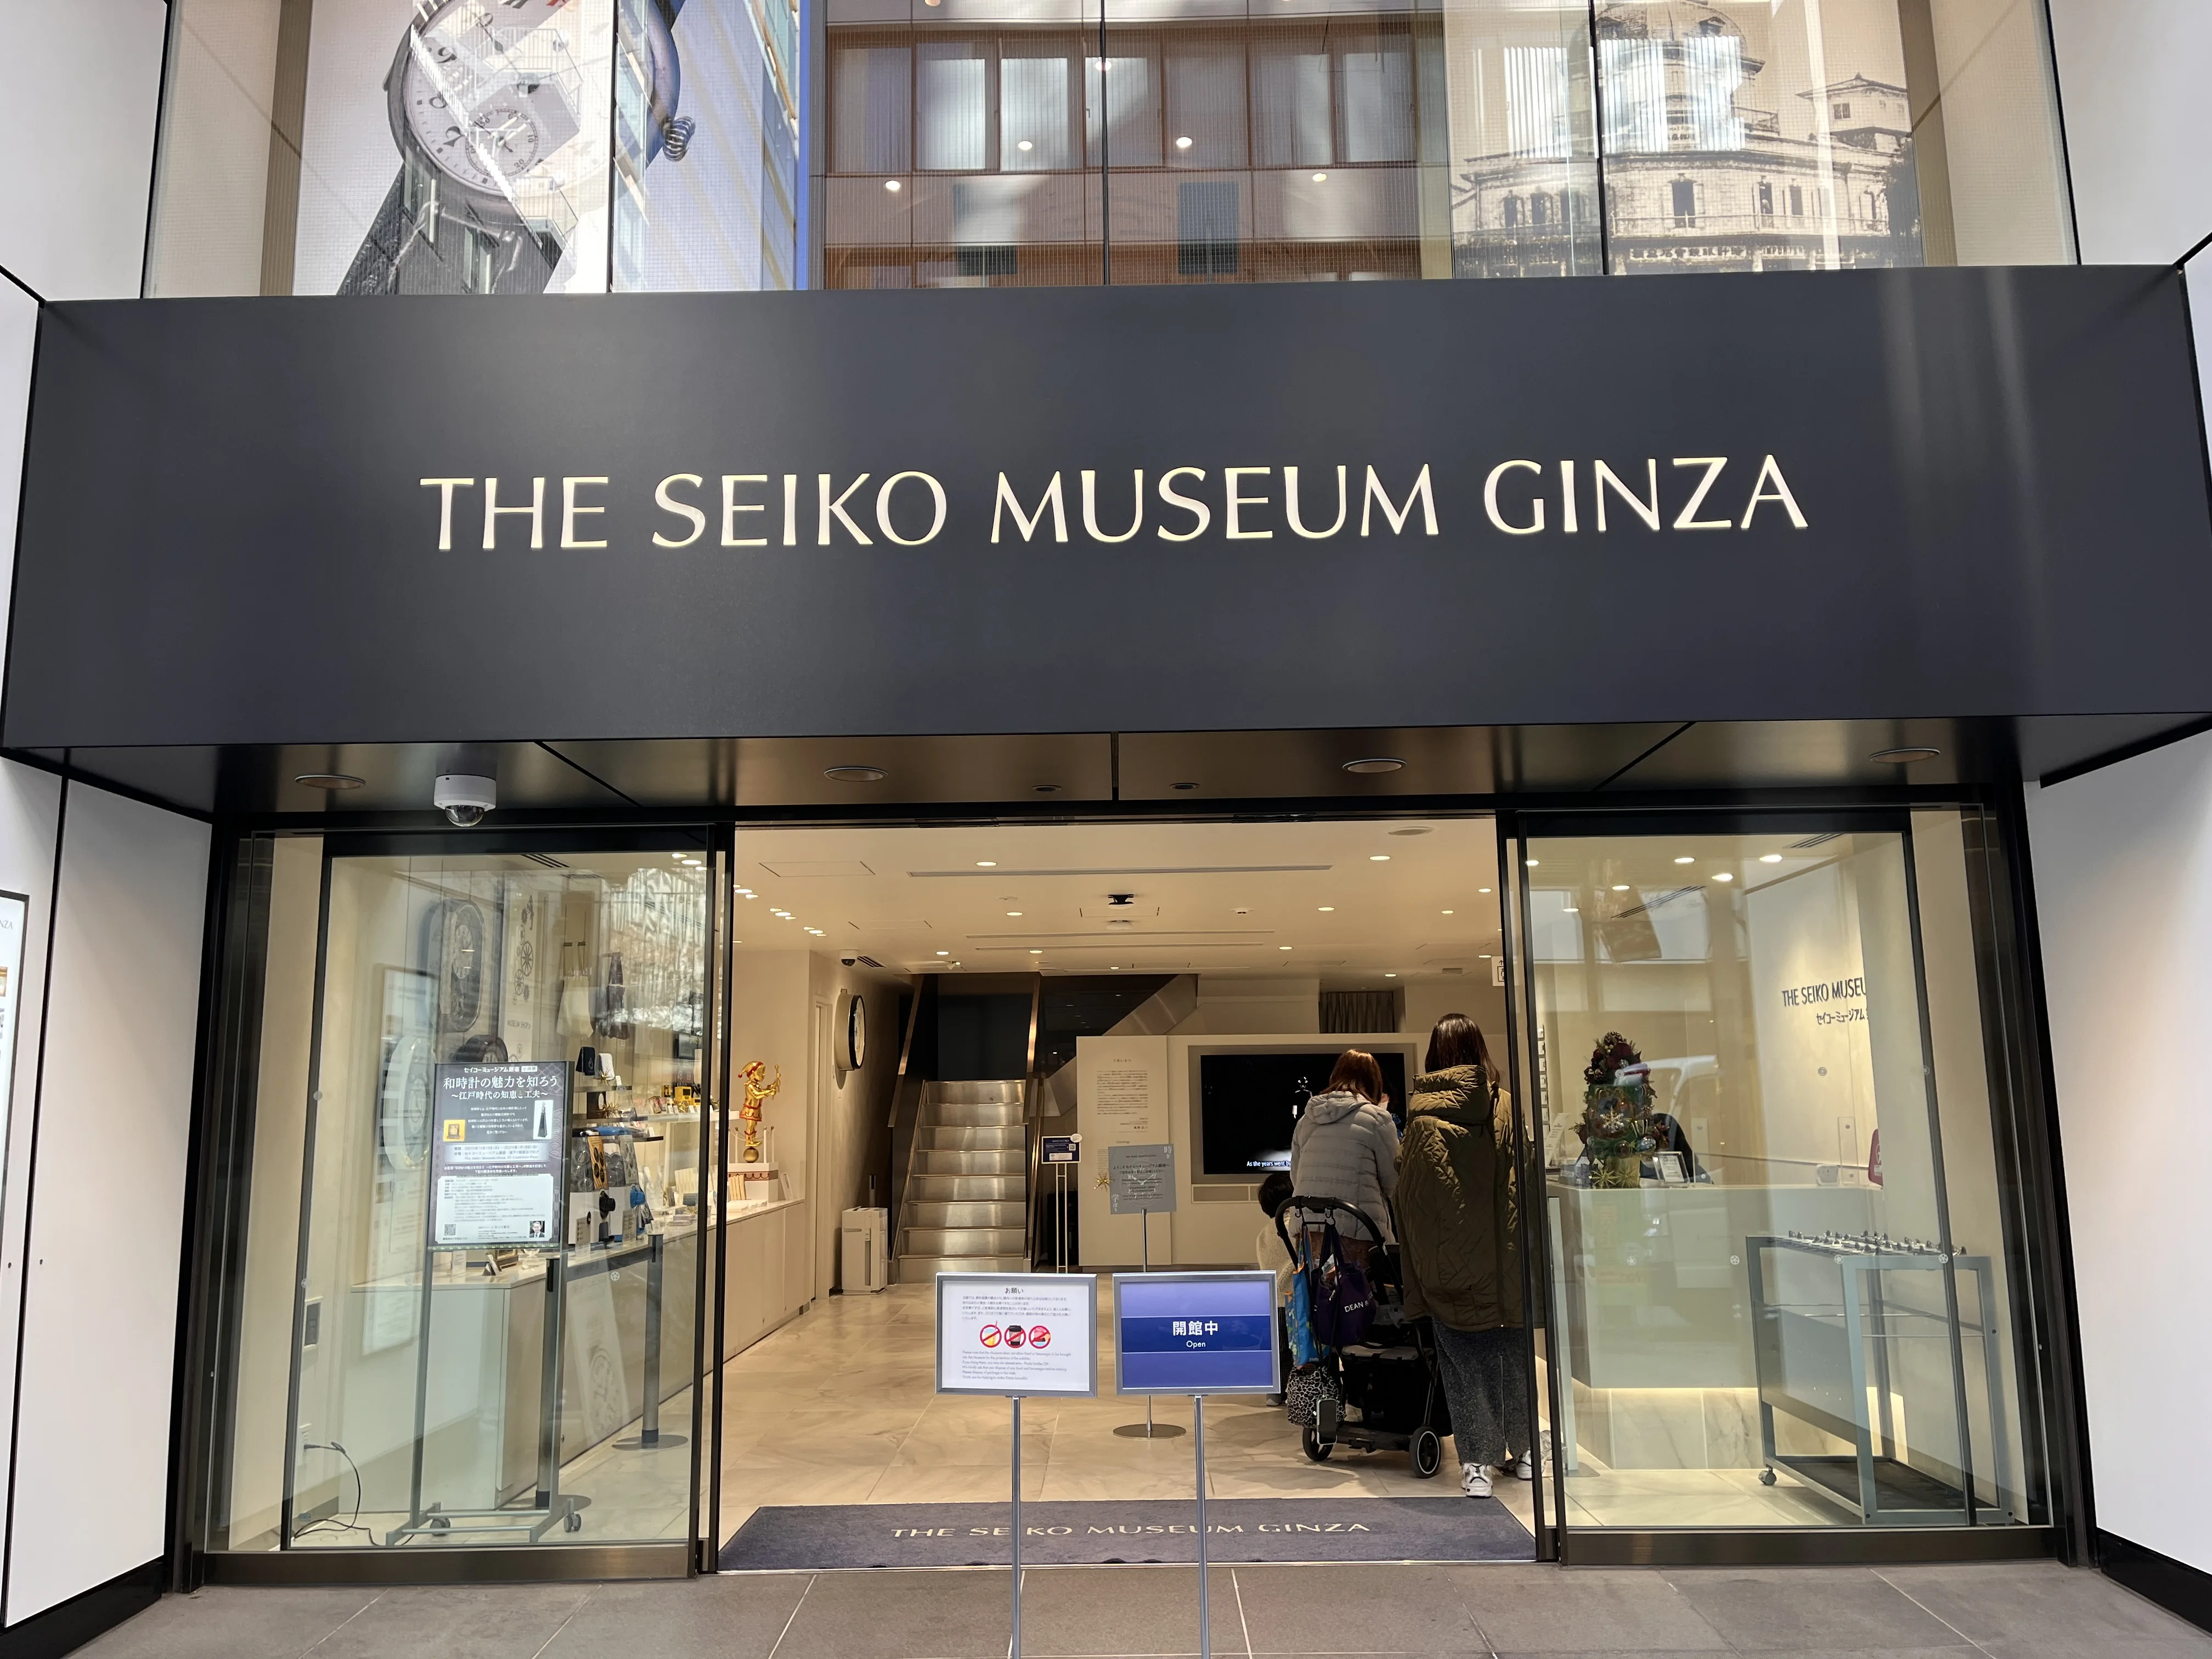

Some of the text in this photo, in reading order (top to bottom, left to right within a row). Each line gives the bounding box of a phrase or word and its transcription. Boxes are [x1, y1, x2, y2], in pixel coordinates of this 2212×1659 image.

[420, 454, 1808, 550] THE SEIKO MUSEUM GINZA
[1782, 989, 1799, 1007] THE
[1801, 983, 1829, 1005] SEIKO
[1816, 1008, 1868, 1025] セイコーミュージアム
[443, 1075, 557, 1090] 和時計の魅力を知ろう
[1344, 1301, 1364, 1313] DEAN
[1172, 1320, 1218, 1336] 開館中
[1186, 1340, 1206, 1350] Open
[890, 1523, 1370, 1537] THE SEKO MUSEUM GINZA
